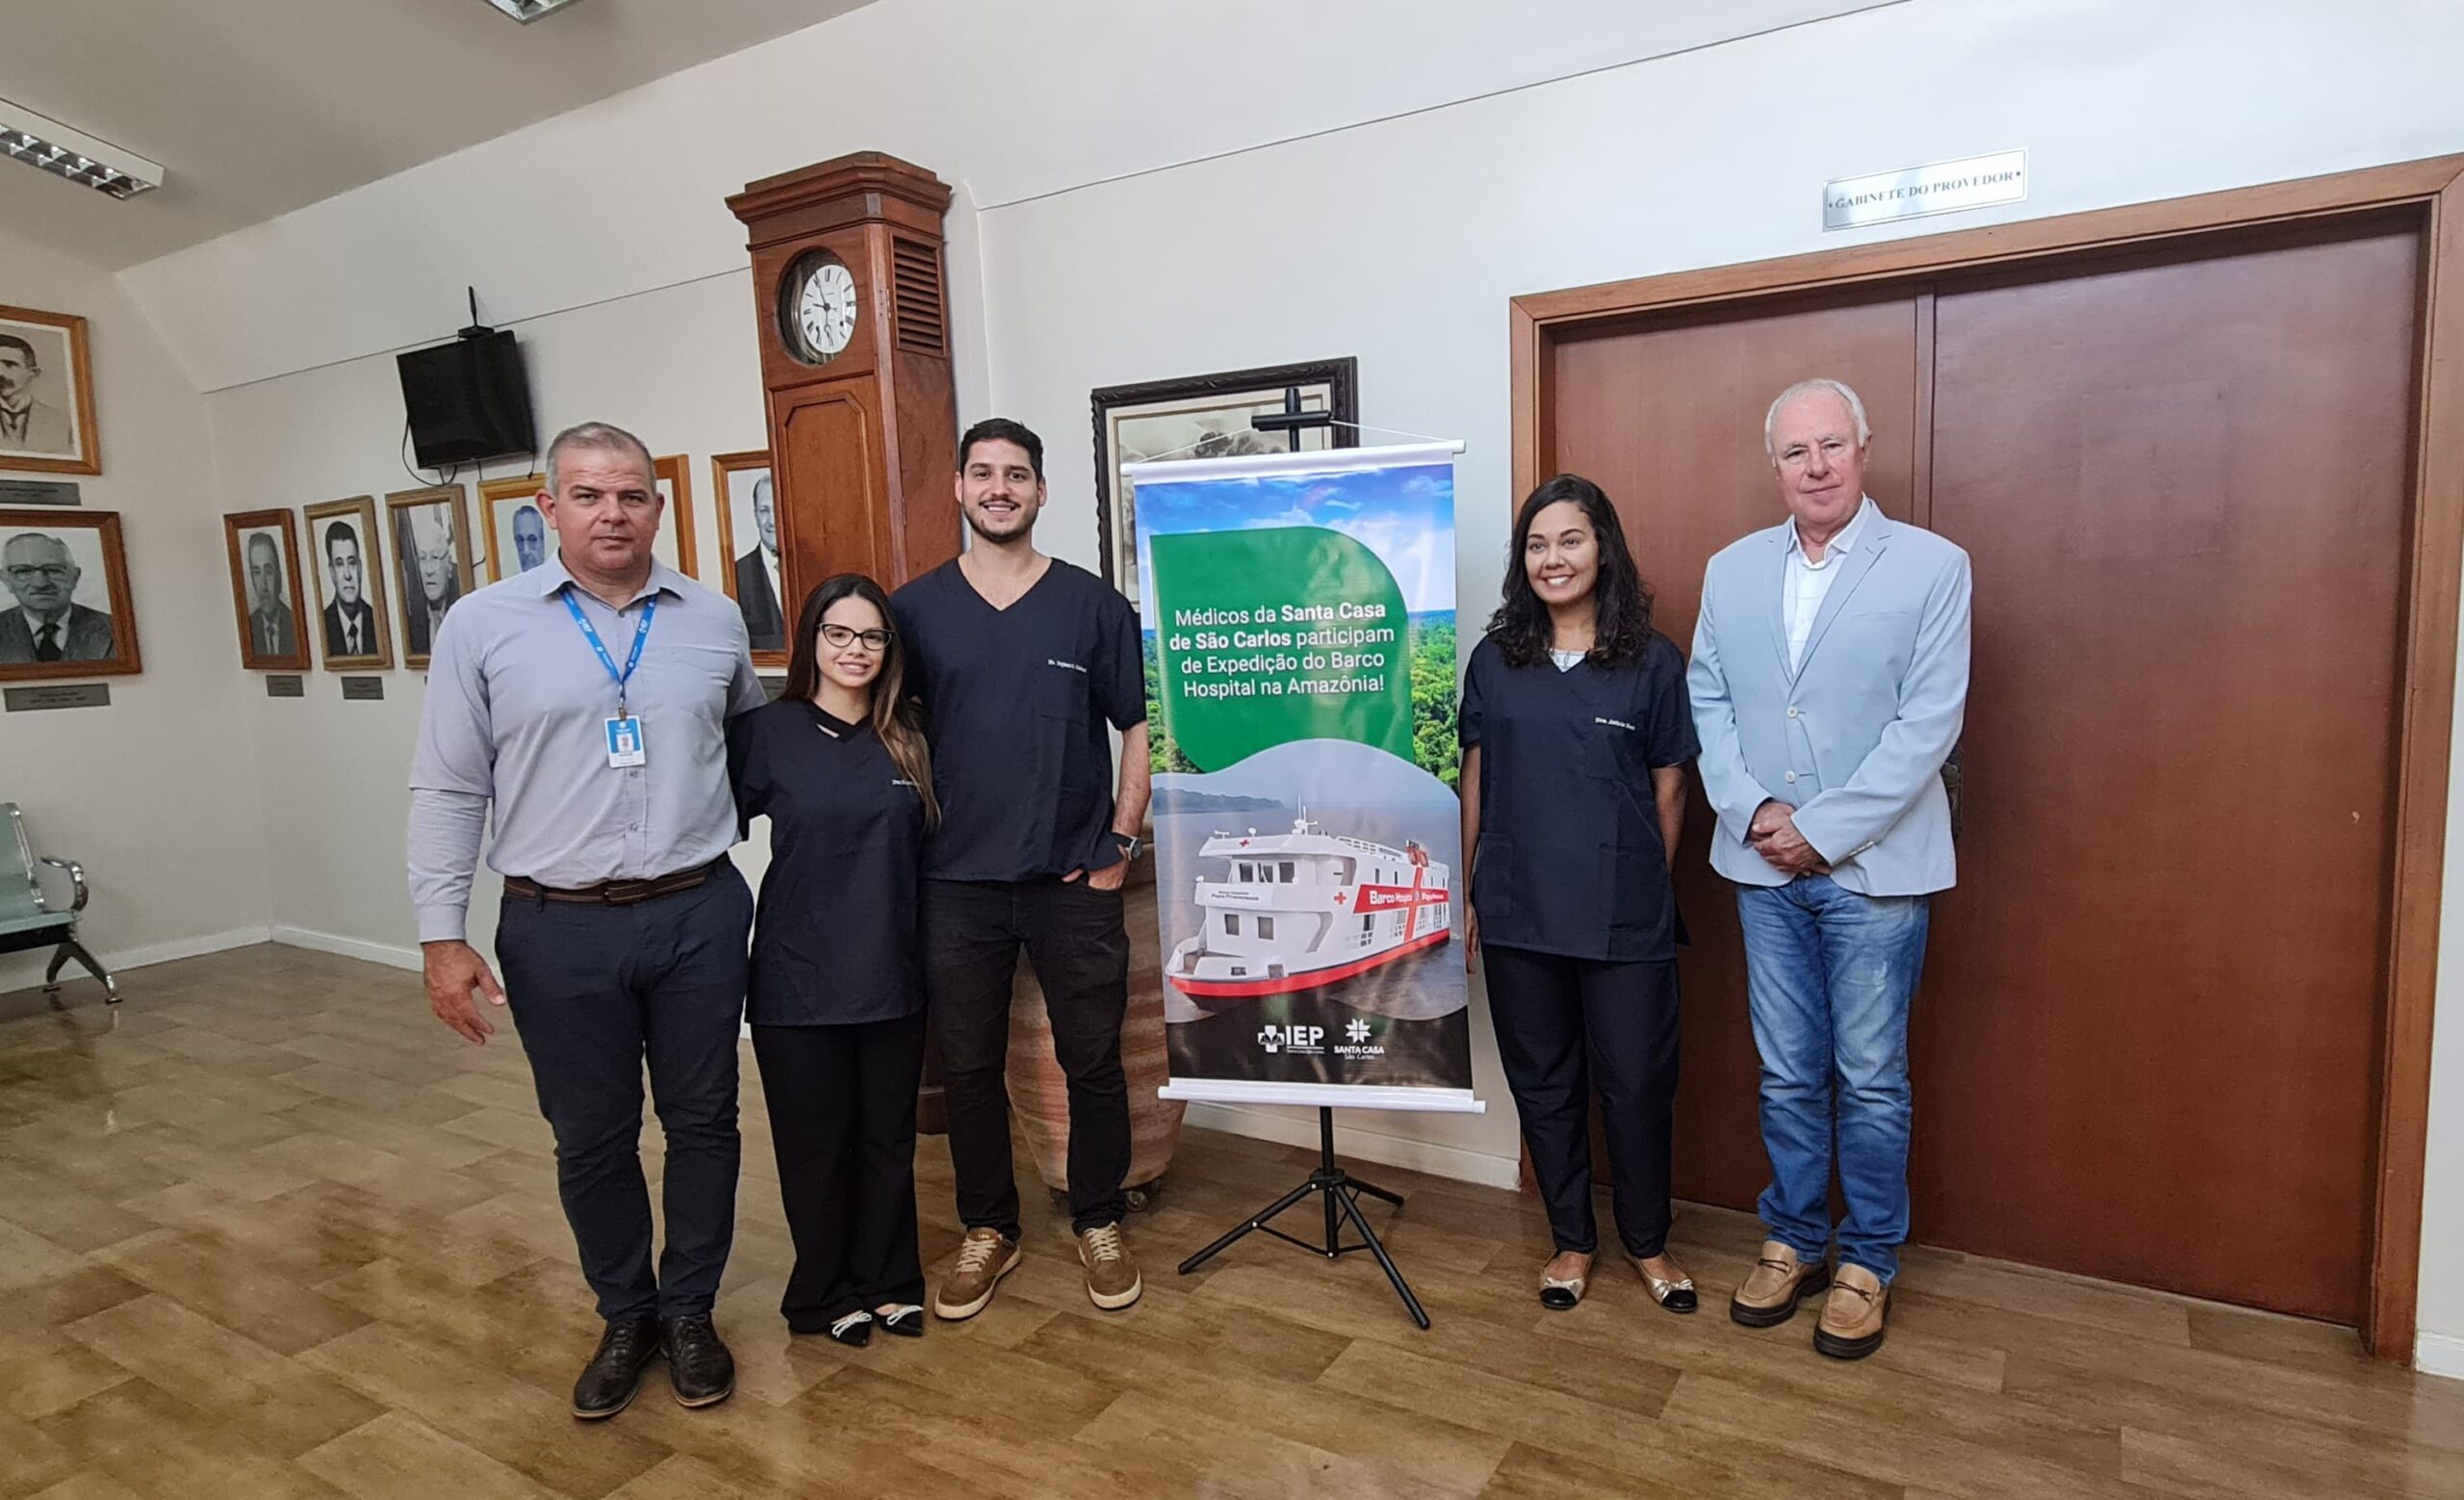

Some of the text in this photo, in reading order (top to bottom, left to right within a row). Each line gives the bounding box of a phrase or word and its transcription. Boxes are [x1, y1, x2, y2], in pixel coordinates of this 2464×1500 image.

[1835, 171, 2014, 209] GABINETE DO PROVEDOR
[1175, 602, 1386, 627] Médicos da Santa Casa
[1169, 626, 1395, 651] de São Carlos participam
[1181, 651, 1385, 676] de Expedição do Barco
[1184, 673, 1384, 700] Hospital na Amazônia!
[1369, 890, 1395, 905] Barco
[1285, 1024, 1324, 1046] IEP
[1334, 1046, 1360, 1054] SANTA
[1361, 1046, 1385, 1055] CASA
